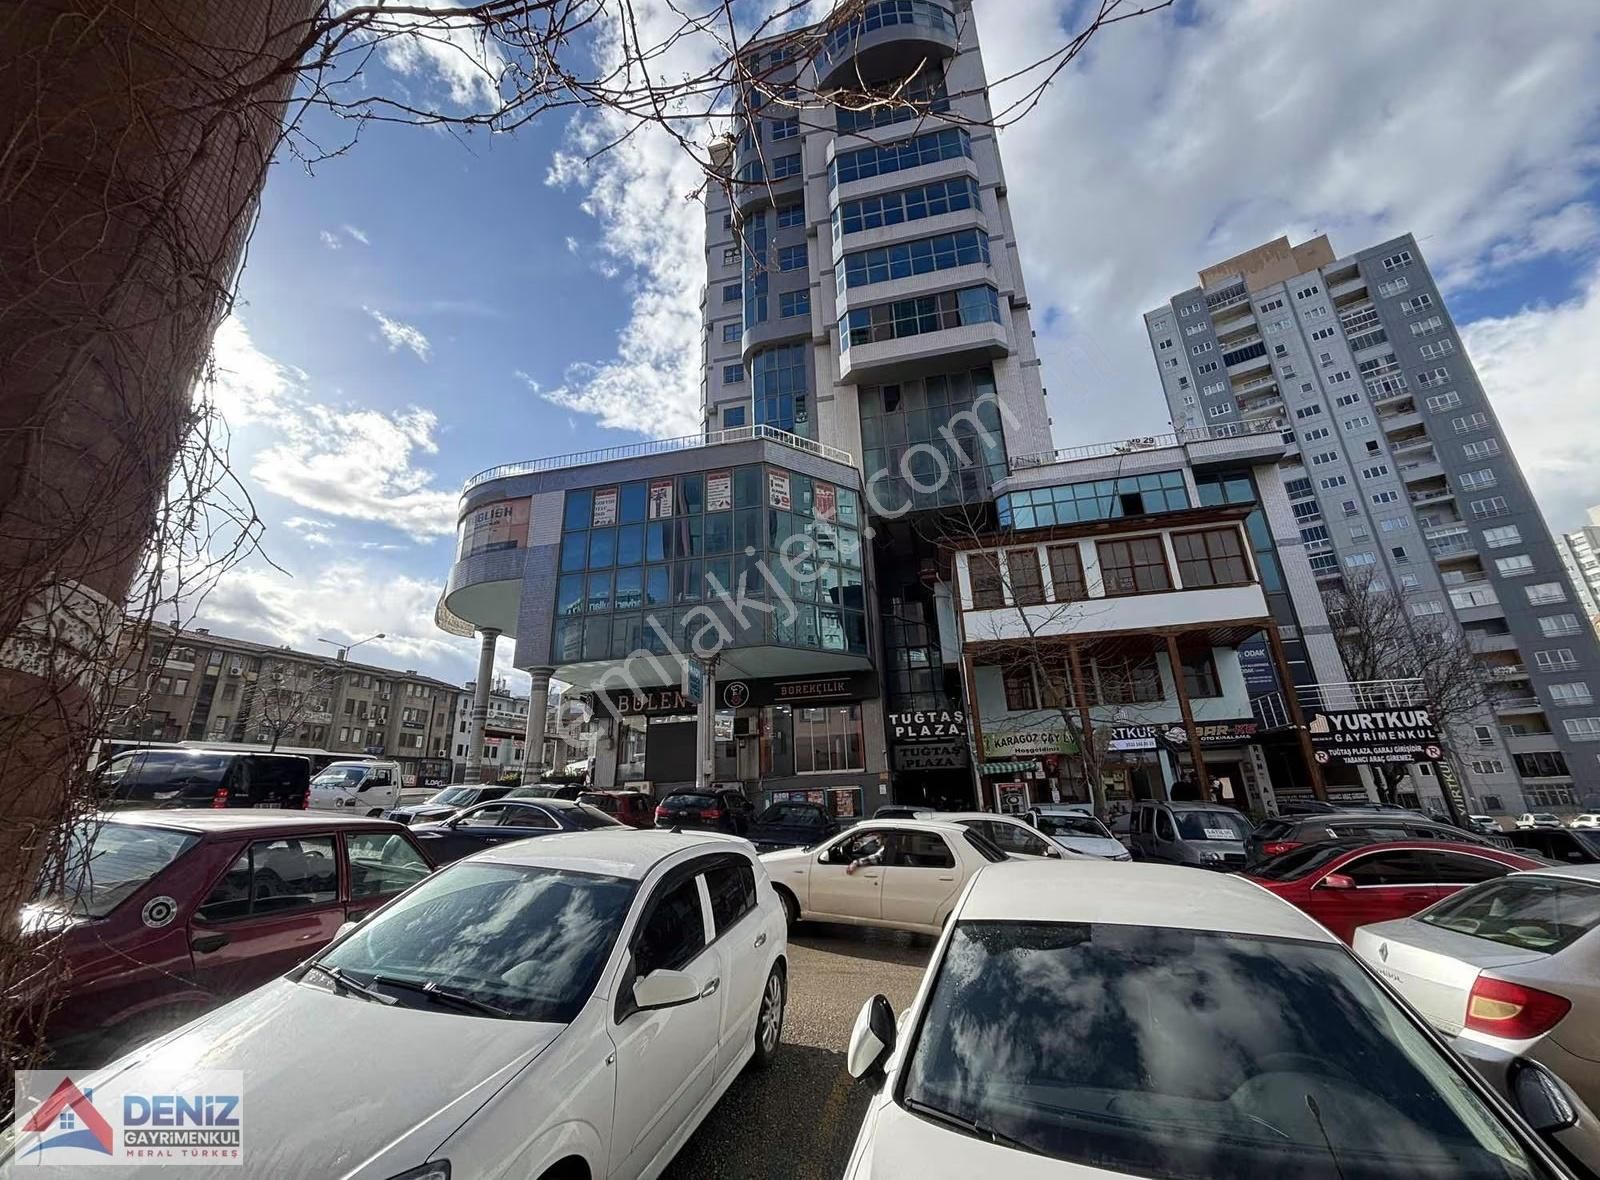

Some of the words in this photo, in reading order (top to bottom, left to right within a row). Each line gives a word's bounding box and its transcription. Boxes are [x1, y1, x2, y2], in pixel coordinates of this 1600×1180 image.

[1244, 649, 1265, 657] ODAK
[889, 711, 964, 725] TUĞTAŞ
[1329, 710, 1432, 731] YURTKUR
[895, 723, 960, 737] PLAZA
[1334, 730, 1436, 743] GAYRİMENKUL
[900, 746, 960, 757] TUĞTAŞ
[1328, 748, 1352, 756] TUĞTAŞ
[906, 758, 956, 768] PLAZA
[1343, 756, 1369, 764] YABANCI
[1369, 755, 1385, 763] ARAÇ
